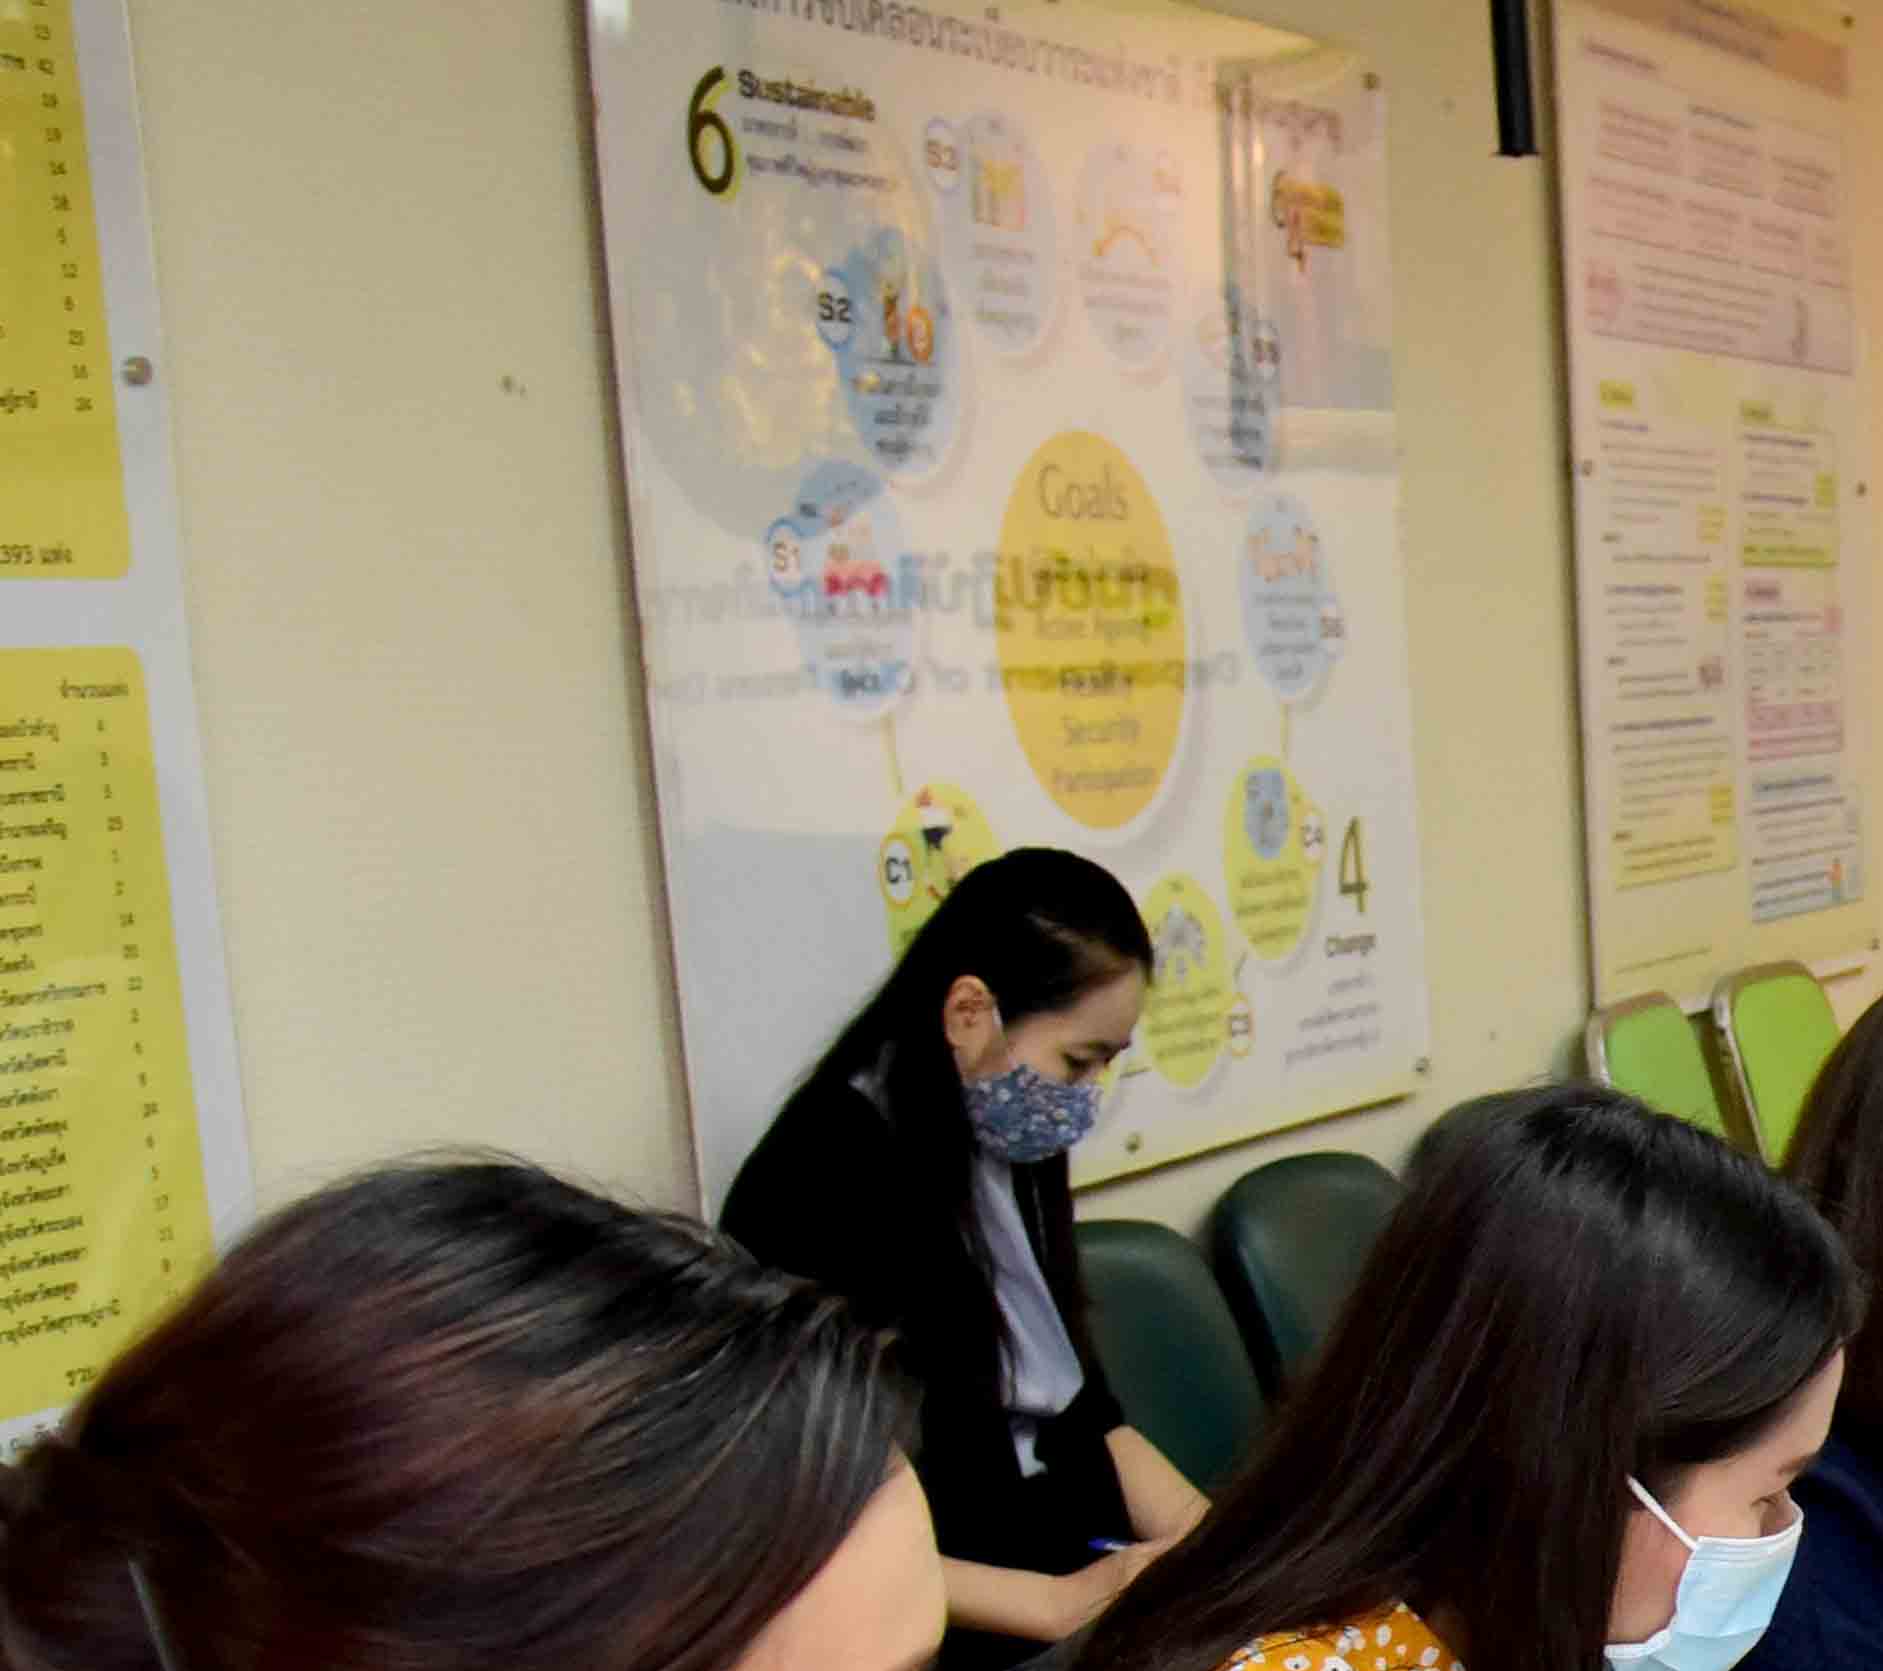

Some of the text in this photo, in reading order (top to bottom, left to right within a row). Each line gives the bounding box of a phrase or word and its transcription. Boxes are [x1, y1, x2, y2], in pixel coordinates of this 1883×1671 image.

[688, 64, 735, 195] 6
[816, 291, 853, 324] S2
[1037, 463, 1129, 520] Goals
[885, 857, 912, 885] C1
[1338, 815, 1370, 914] 4
